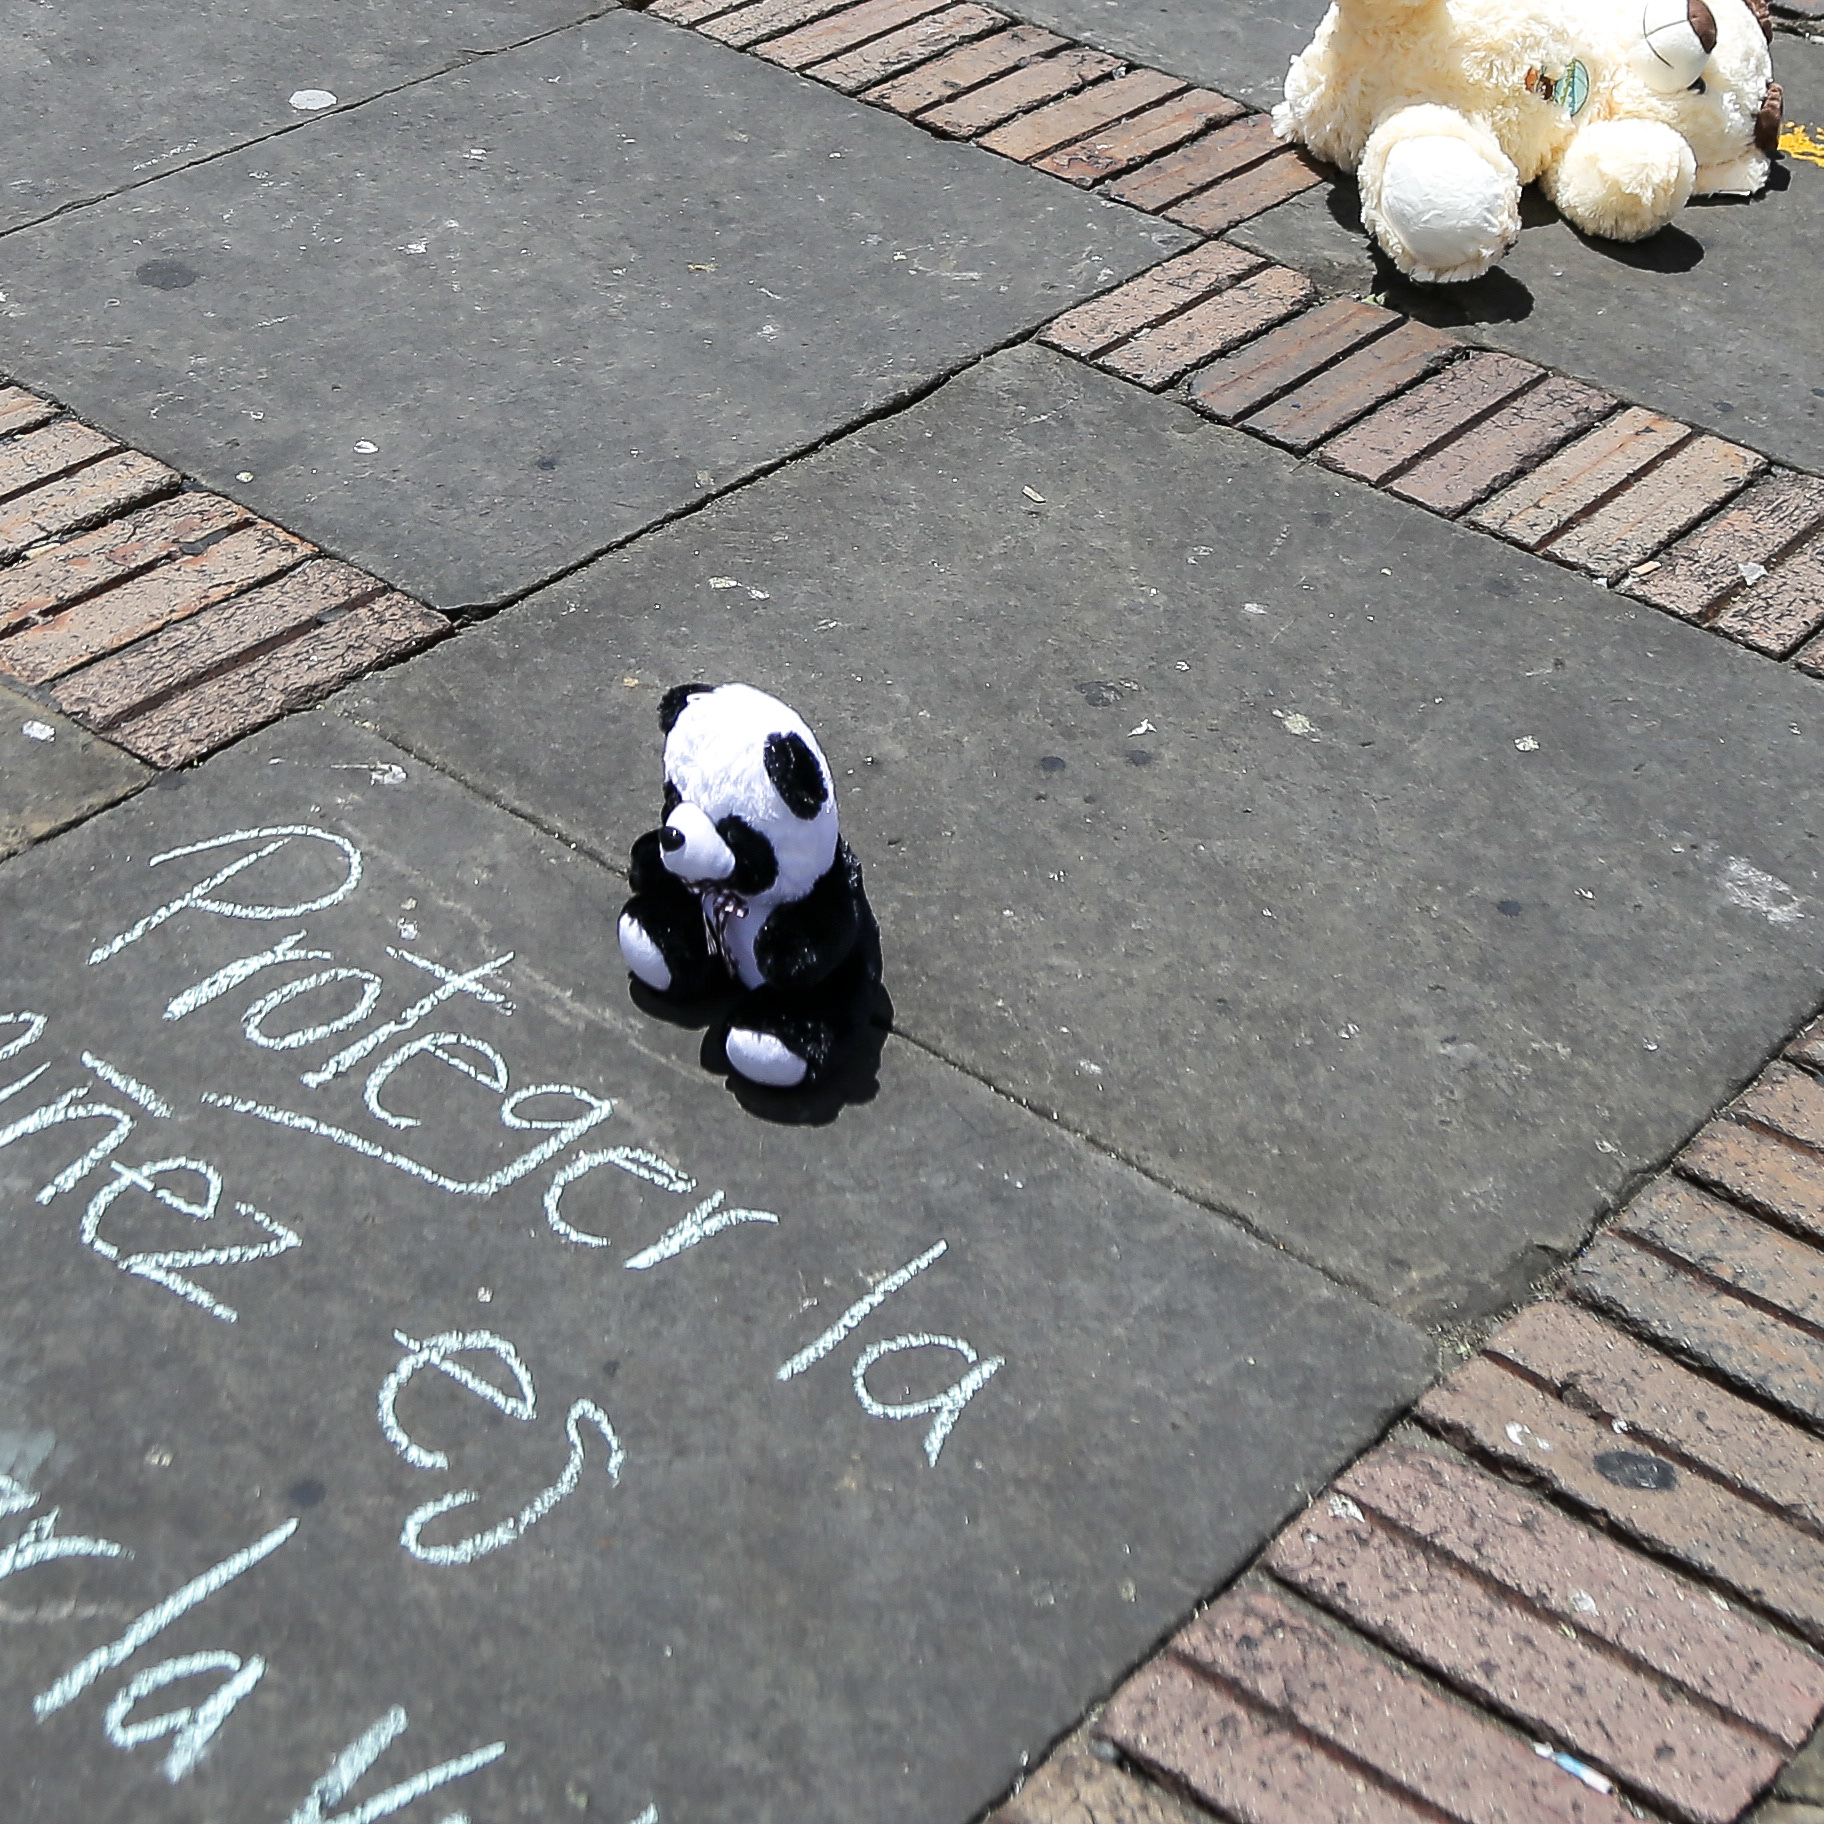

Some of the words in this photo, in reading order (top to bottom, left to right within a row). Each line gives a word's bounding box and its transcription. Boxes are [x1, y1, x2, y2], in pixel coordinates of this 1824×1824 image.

[87, 824, 781, 1271] Proteger
[774, 1239, 1007, 1469] la
[375, 1327, 629, 1567] es
[33, 1516, 301, 1784] la
